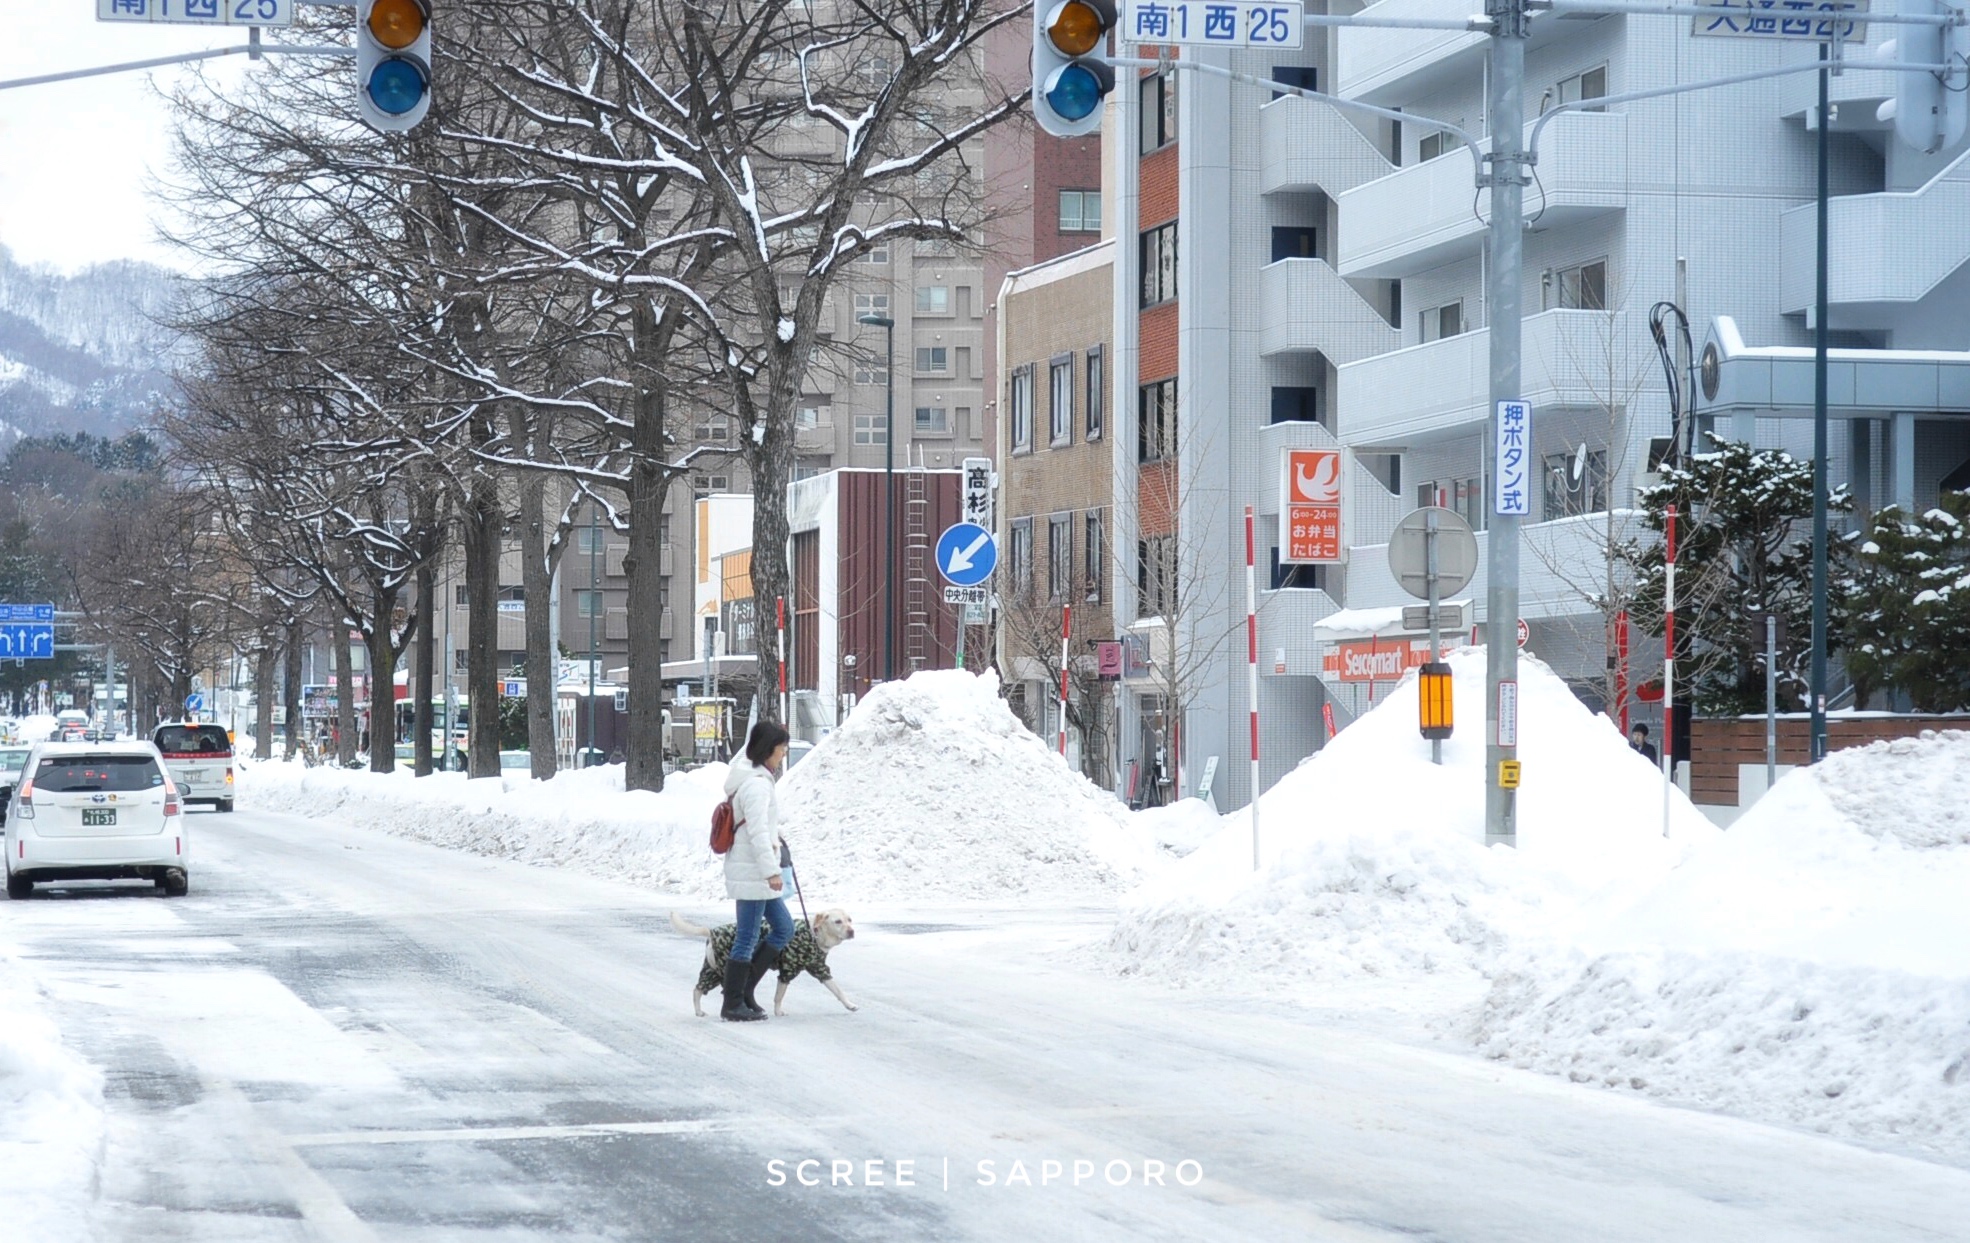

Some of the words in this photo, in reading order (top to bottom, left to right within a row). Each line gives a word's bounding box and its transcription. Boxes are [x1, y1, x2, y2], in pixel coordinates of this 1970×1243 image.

[1502, 404, 1524, 511] 押ボタン式
[1293, 524, 1336, 539] お弁当
[1293, 543, 1336, 557] たばこ
[945, 588, 986, 603] 中央分離帯
